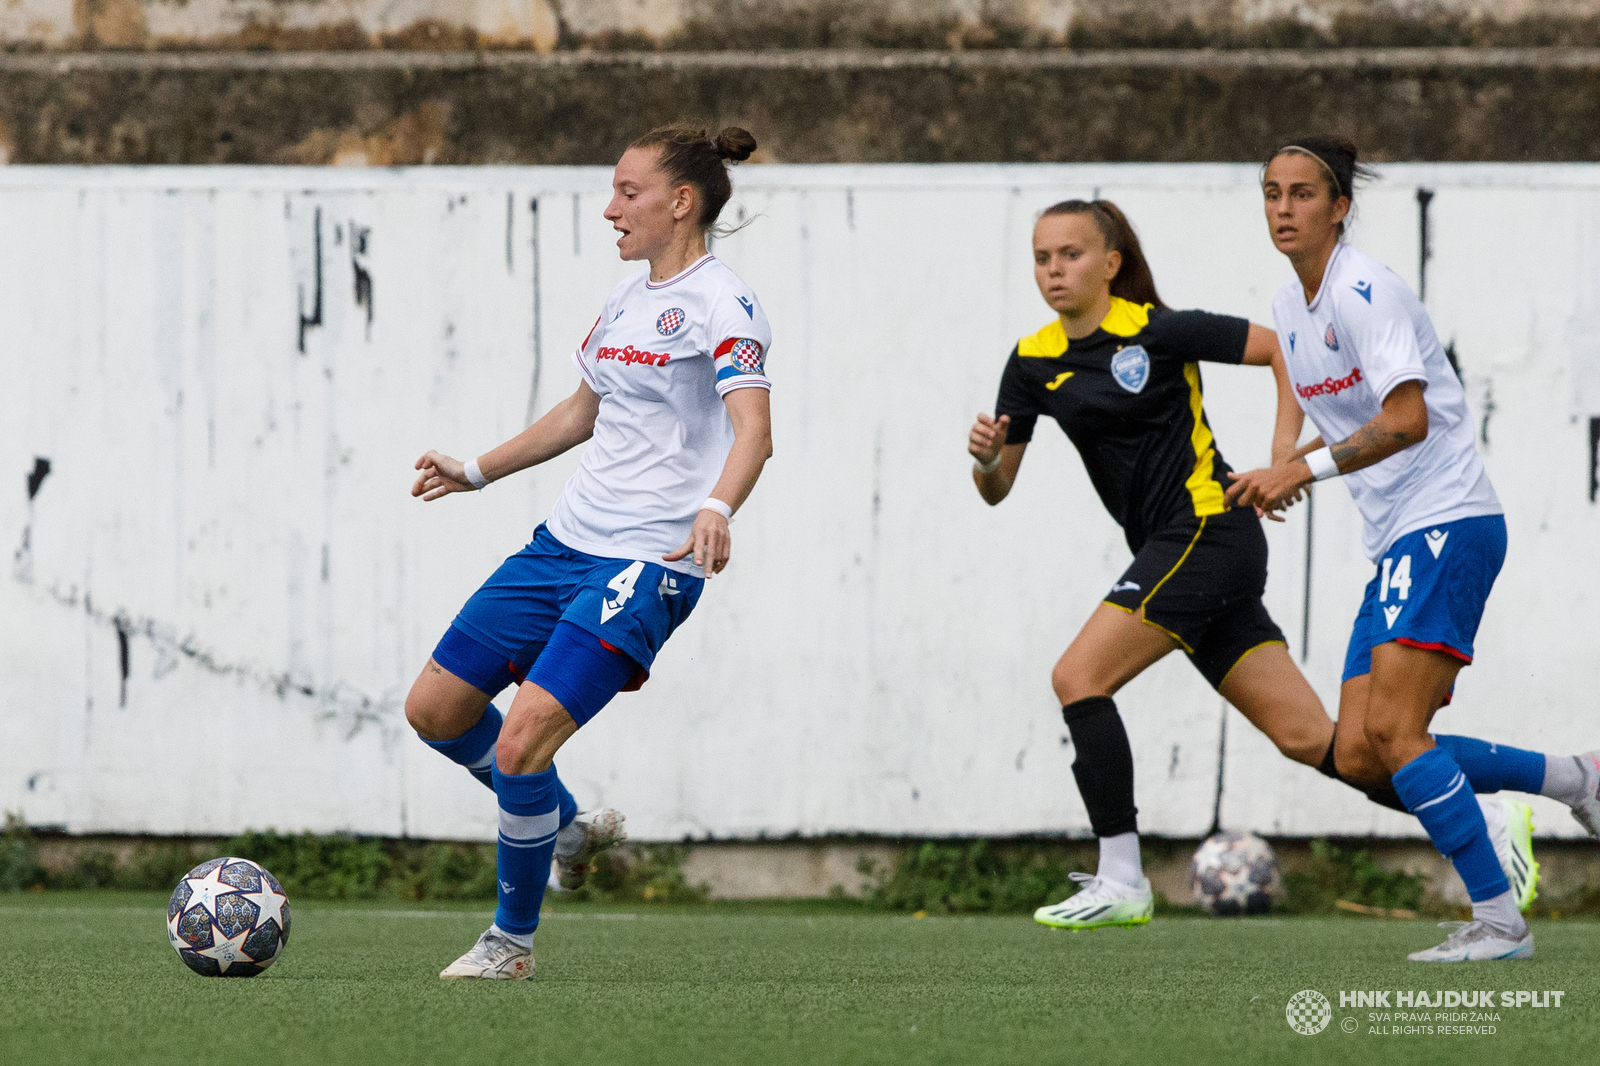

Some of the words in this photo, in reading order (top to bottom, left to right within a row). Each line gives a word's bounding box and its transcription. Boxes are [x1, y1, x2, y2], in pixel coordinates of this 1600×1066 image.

[596, 345, 671, 367] perSport
[739, 365, 762, 373] SPLIT
[1296, 367, 1363, 401] SuperSport
[607, 560, 646, 607] 4
[1379, 554, 1412, 603] 14
